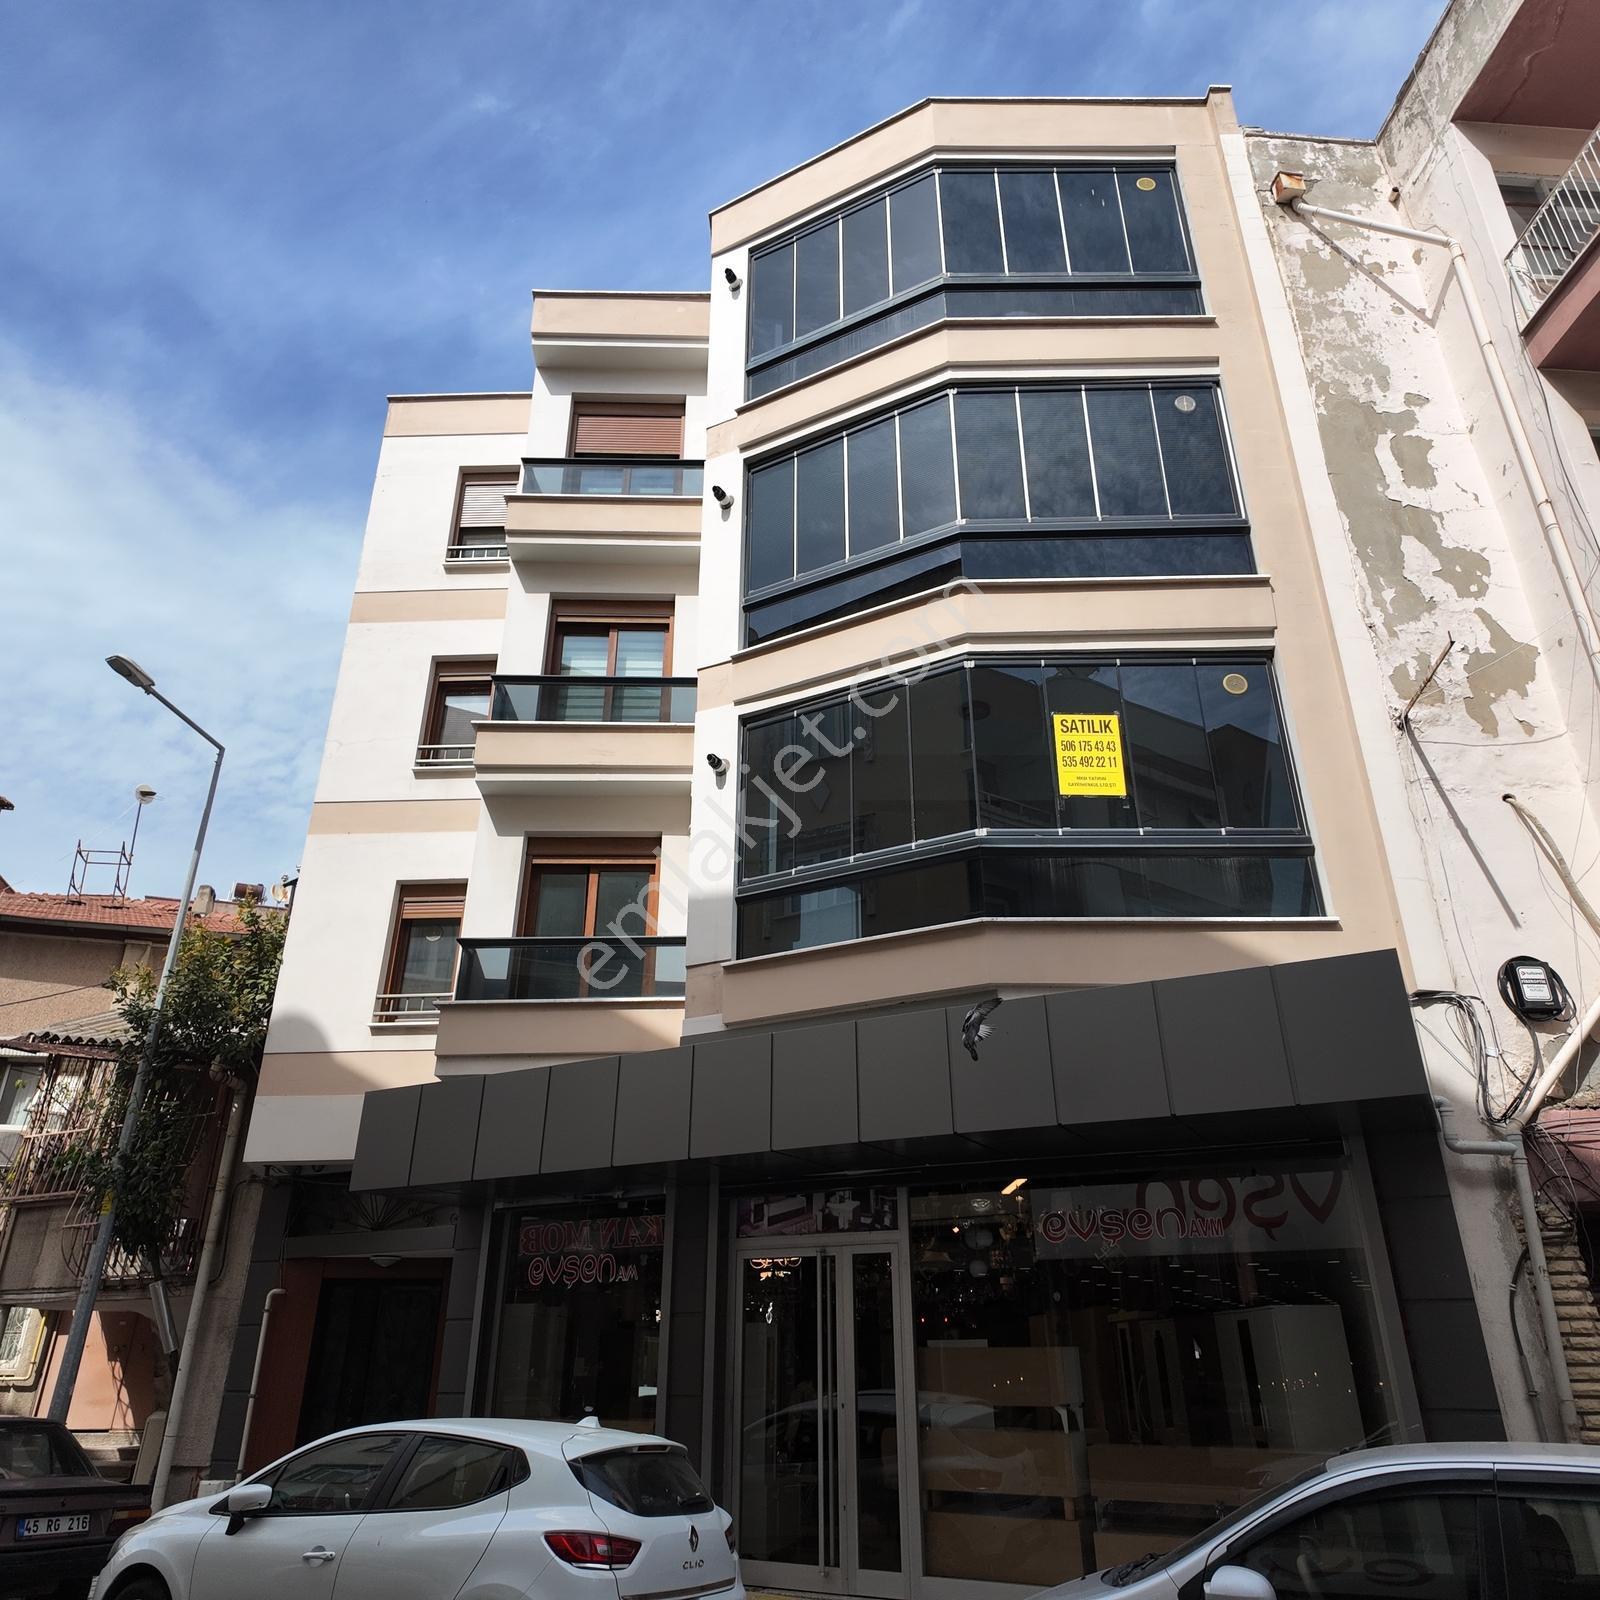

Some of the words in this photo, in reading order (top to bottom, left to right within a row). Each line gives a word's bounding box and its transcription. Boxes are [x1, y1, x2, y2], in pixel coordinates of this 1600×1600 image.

[1060, 719, 1113, 734] SATILIK
[1061, 740, 1076, 752] 506
[1079, 740, 1093, 752] 175
[1094, 740, 1105, 752] 43
[1106, 740, 1117, 752] 43
[1062, 756, 1078, 768] 535
[1079, 756, 1095, 768] 492
[1095, 756, 1106, 768] 22
[1108, 756, 1117, 768] 11
[1041, 1207, 1188, 1247] evşen
[1187, 1217, 1225, 1239] AVM
[528, 1253, 617, 1289] evşen
[25, 1520, 39, 1533] 45
[47, 1519, 60, 1532] RG
[68, 1516, 88, 1530] 216
[682, 1559, 705, 1570] CLIO
